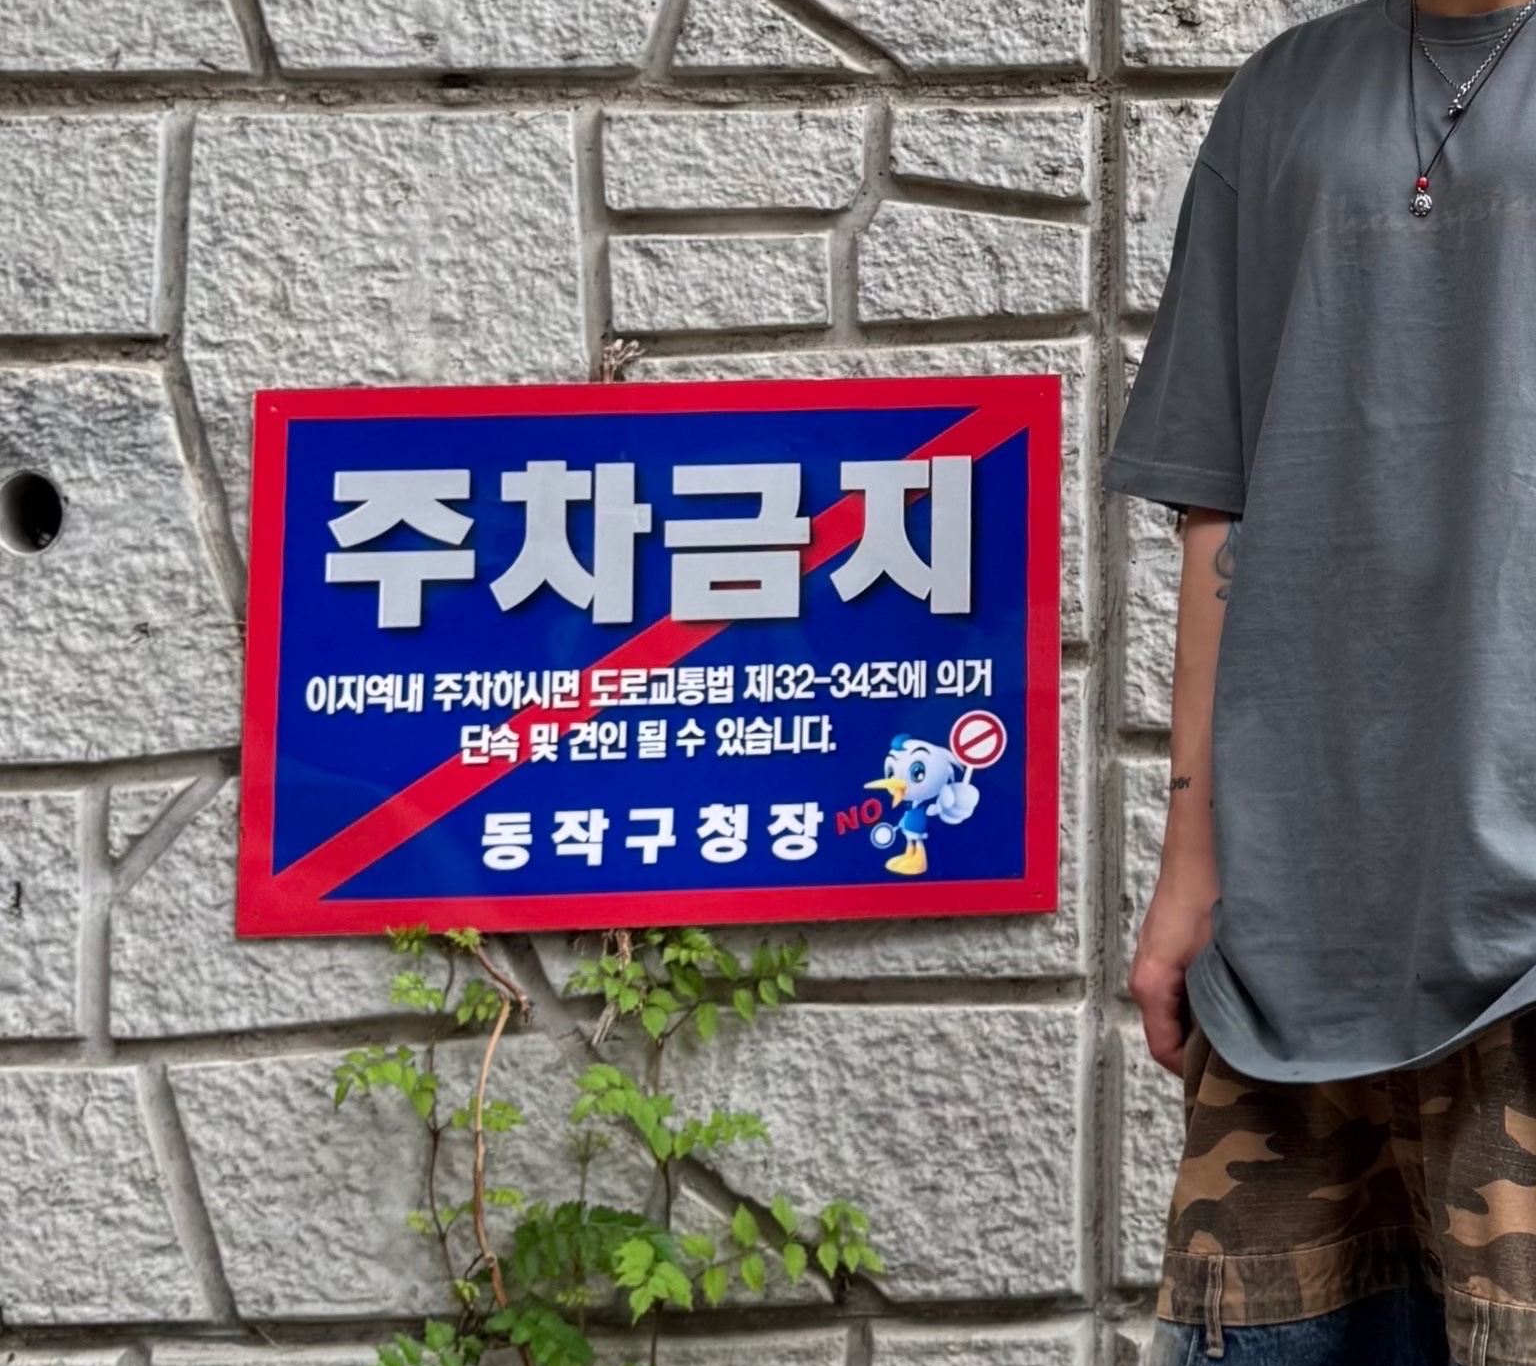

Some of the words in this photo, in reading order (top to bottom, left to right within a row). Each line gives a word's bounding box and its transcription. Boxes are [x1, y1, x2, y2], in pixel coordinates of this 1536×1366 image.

[325, 455, 974, 628] 주차금지
[305, 673, 424, 715] 이지역내
[433, 670, 580, 711] 주차하시면
[589, 665, 735, 708] 도로교통법
[743, 659, 927, 703] 제32-34조에
[936, 659, 992, 698] 의거
[460, 723, 520, 764] 단속
[529, 722, 559, 762] 및
[568, 720, 627, 761] 견인
[637, 719, 668, 759] 될
[676, 719, 706, 757] 수
[715, 715, 838, 757] 있습니다.
[836, 798, 883, 835] NO
